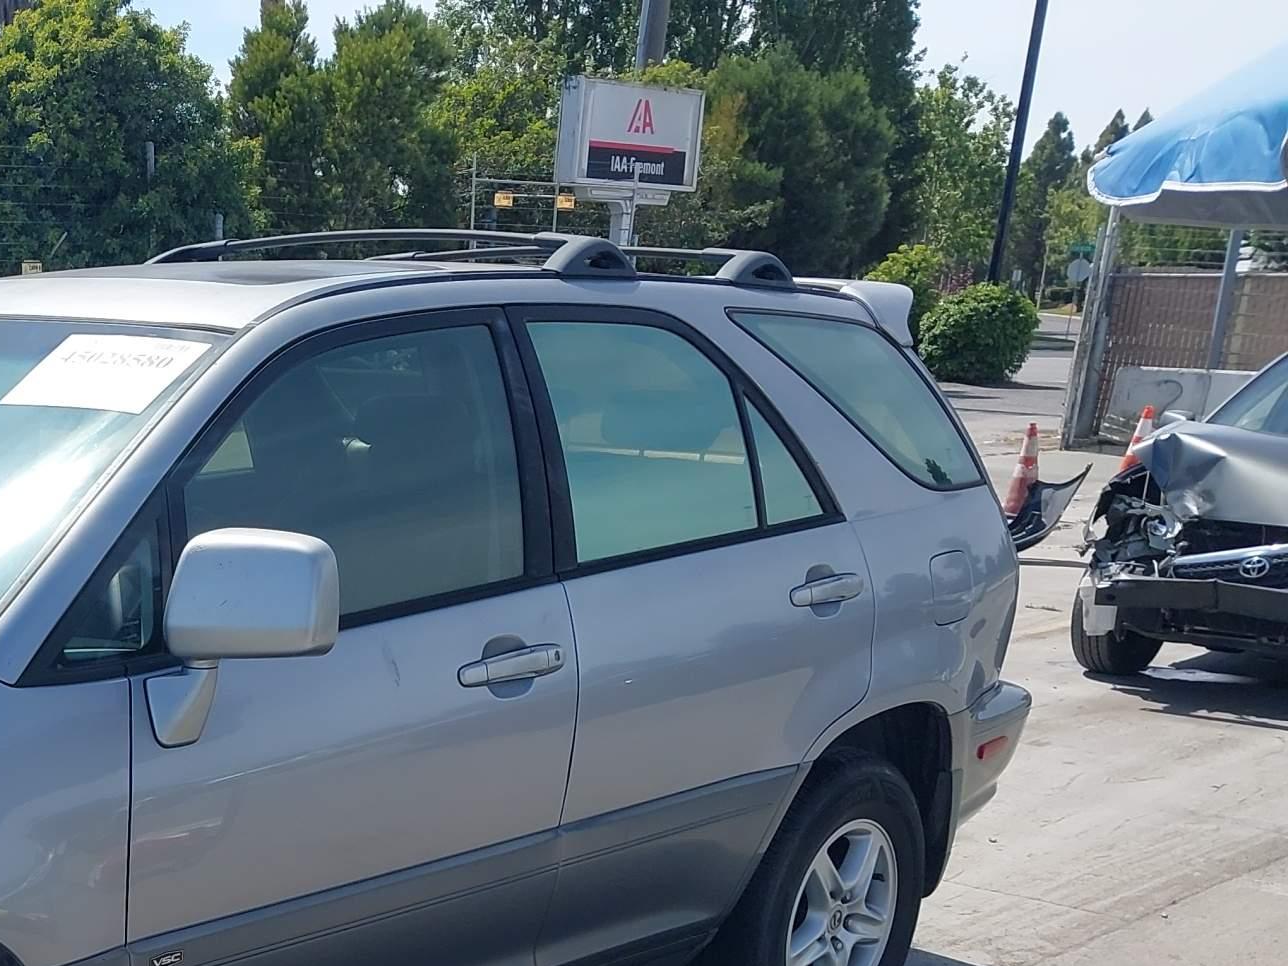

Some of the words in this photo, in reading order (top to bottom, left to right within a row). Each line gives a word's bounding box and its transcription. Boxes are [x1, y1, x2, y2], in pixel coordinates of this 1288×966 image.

[611, 156, 628, 172] IAA
[630, 157, 664, 175] Femont
[153, 952, 181, 966] VSC
